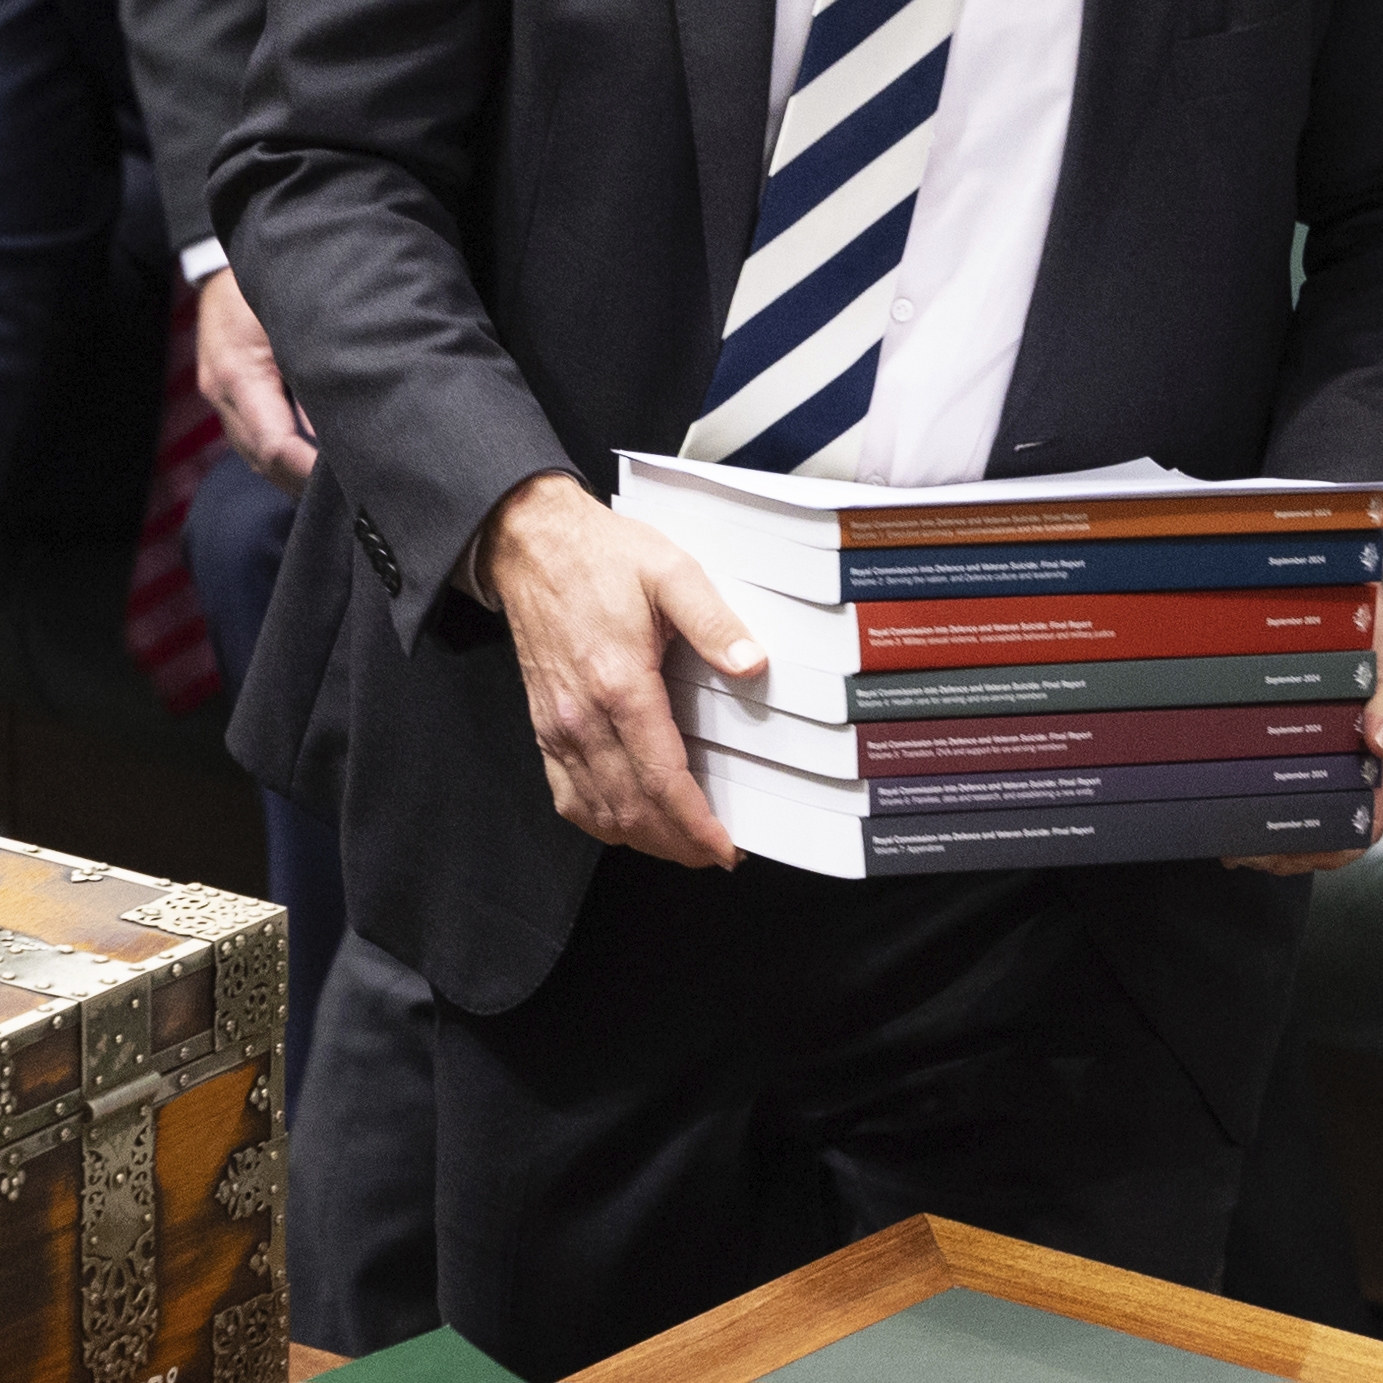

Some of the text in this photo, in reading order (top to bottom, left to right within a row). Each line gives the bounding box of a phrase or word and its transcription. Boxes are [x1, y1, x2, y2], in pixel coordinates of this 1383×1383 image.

[1268, 556, 1326, 567] September 2024
[1266, 616, 1321, 628] September 2024
[1265, 674, 1321, 686] September 2024
[855, 688, 877, 699] Royal
[877, 686, 922, 696] Commission
[938, 684, 968, 694] Defence
[983, 682, 1011, 692] Veteran
[1041, 680, 1060, 689] Final
[1060, 679, 1086, 690] Report
[1267, 724, 1322, 736] September 2024
[866, 740, 888, 750] Royal
[888, 738, 933, 747] Commission
[947, 736, 978, 745] Defence
[992, 734, 1019, 743] Veteran
[1049, 732, 1067, 740] Final
[1067, 731, 1093, 741] Report
[1274, 770, 1328, 782] September 2024
[1266, 819, 1320, 830] September 2024
[872, 834, 894, 845] Royal
[893, 832, 937, 842] Commission
[952, 830, 981, 840] Defence
[996, 828, 1023, 838] Veteran
[1051, 826, 1069, 835] Final
[1070, 825, 1095, 836] Report
